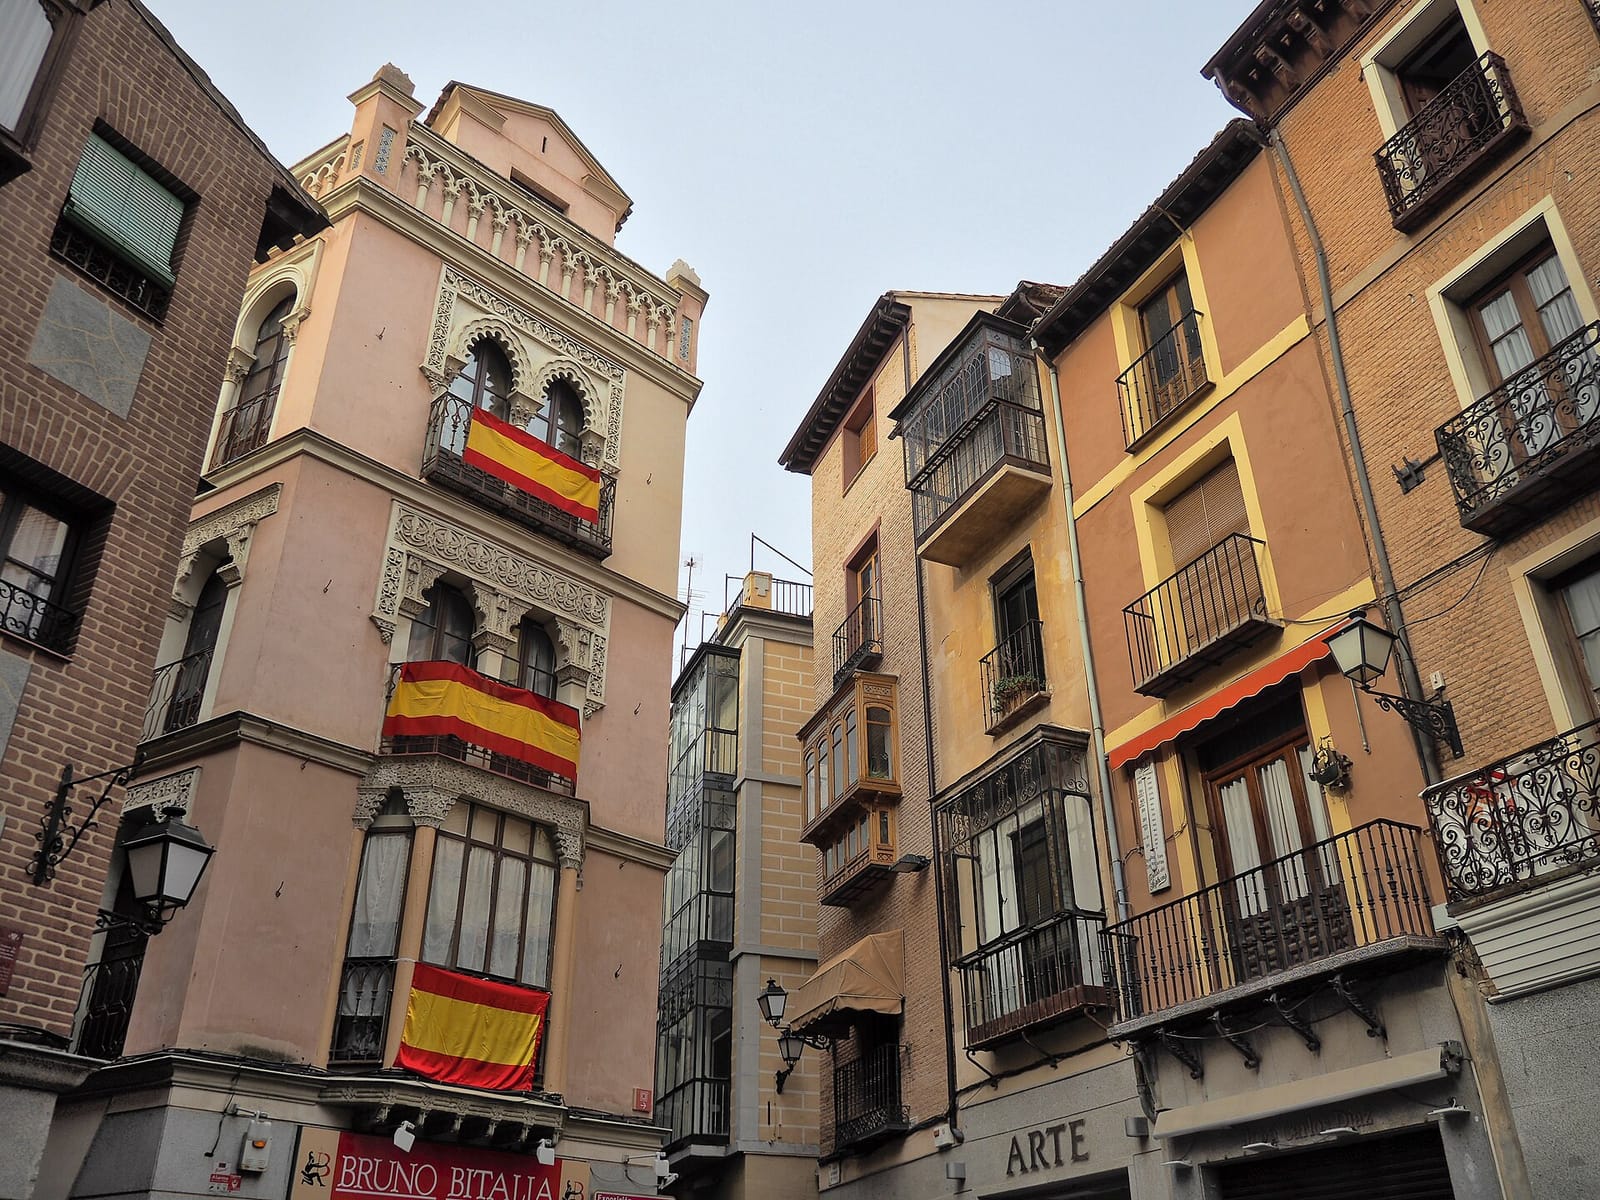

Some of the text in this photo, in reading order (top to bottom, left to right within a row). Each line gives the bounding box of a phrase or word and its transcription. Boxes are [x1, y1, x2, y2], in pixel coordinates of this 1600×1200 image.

[1006, 1118, 1089, 1177] ARTE
[336, 1155, 554, 1200] BRUNO BITALIA
